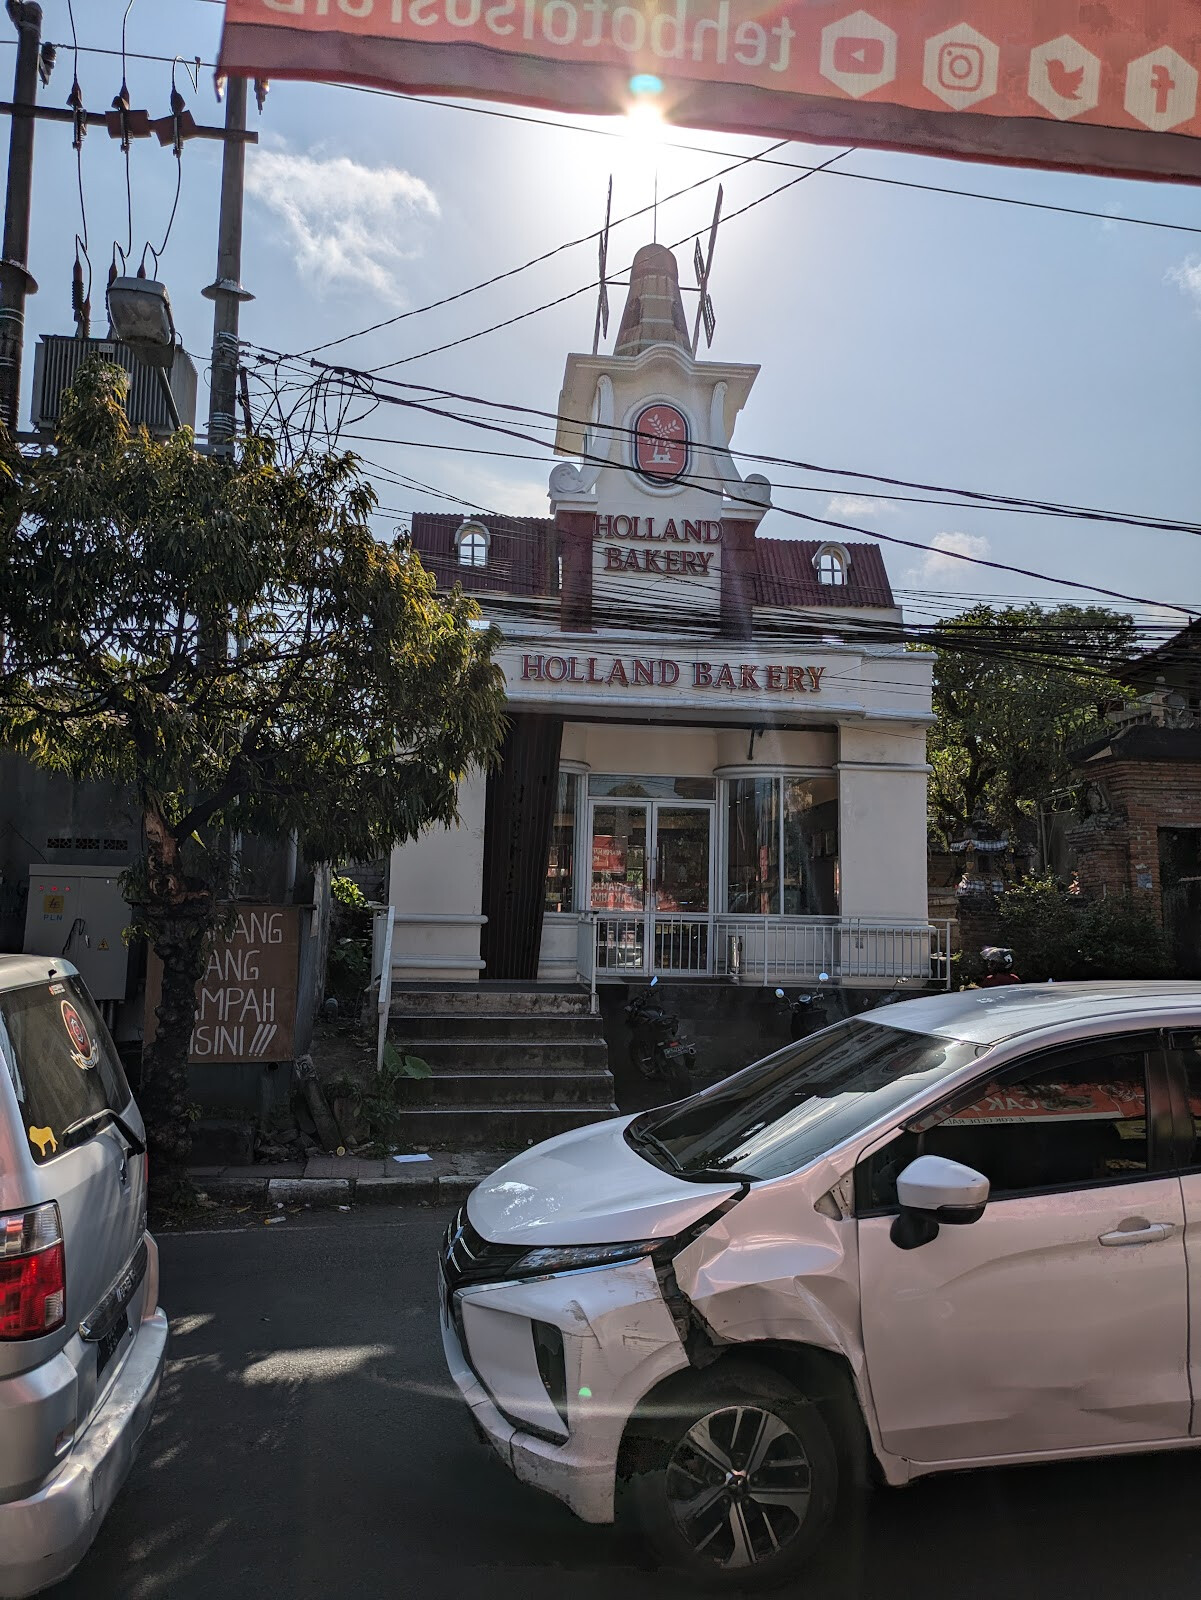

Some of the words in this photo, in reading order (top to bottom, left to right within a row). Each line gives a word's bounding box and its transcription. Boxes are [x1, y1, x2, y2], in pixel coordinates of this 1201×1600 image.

[592, 514, 724, 544] HOLLAND
[603, 547, 715, 576] BAKERY
[521, 654, 680, 686] HOLLAND
[692, 662, 826, 692] BAKERY
[43, 914, 63, 922] PLN
[199, 949, 260, 981] ANG
[195, 987, 275, 1023] MPAH
